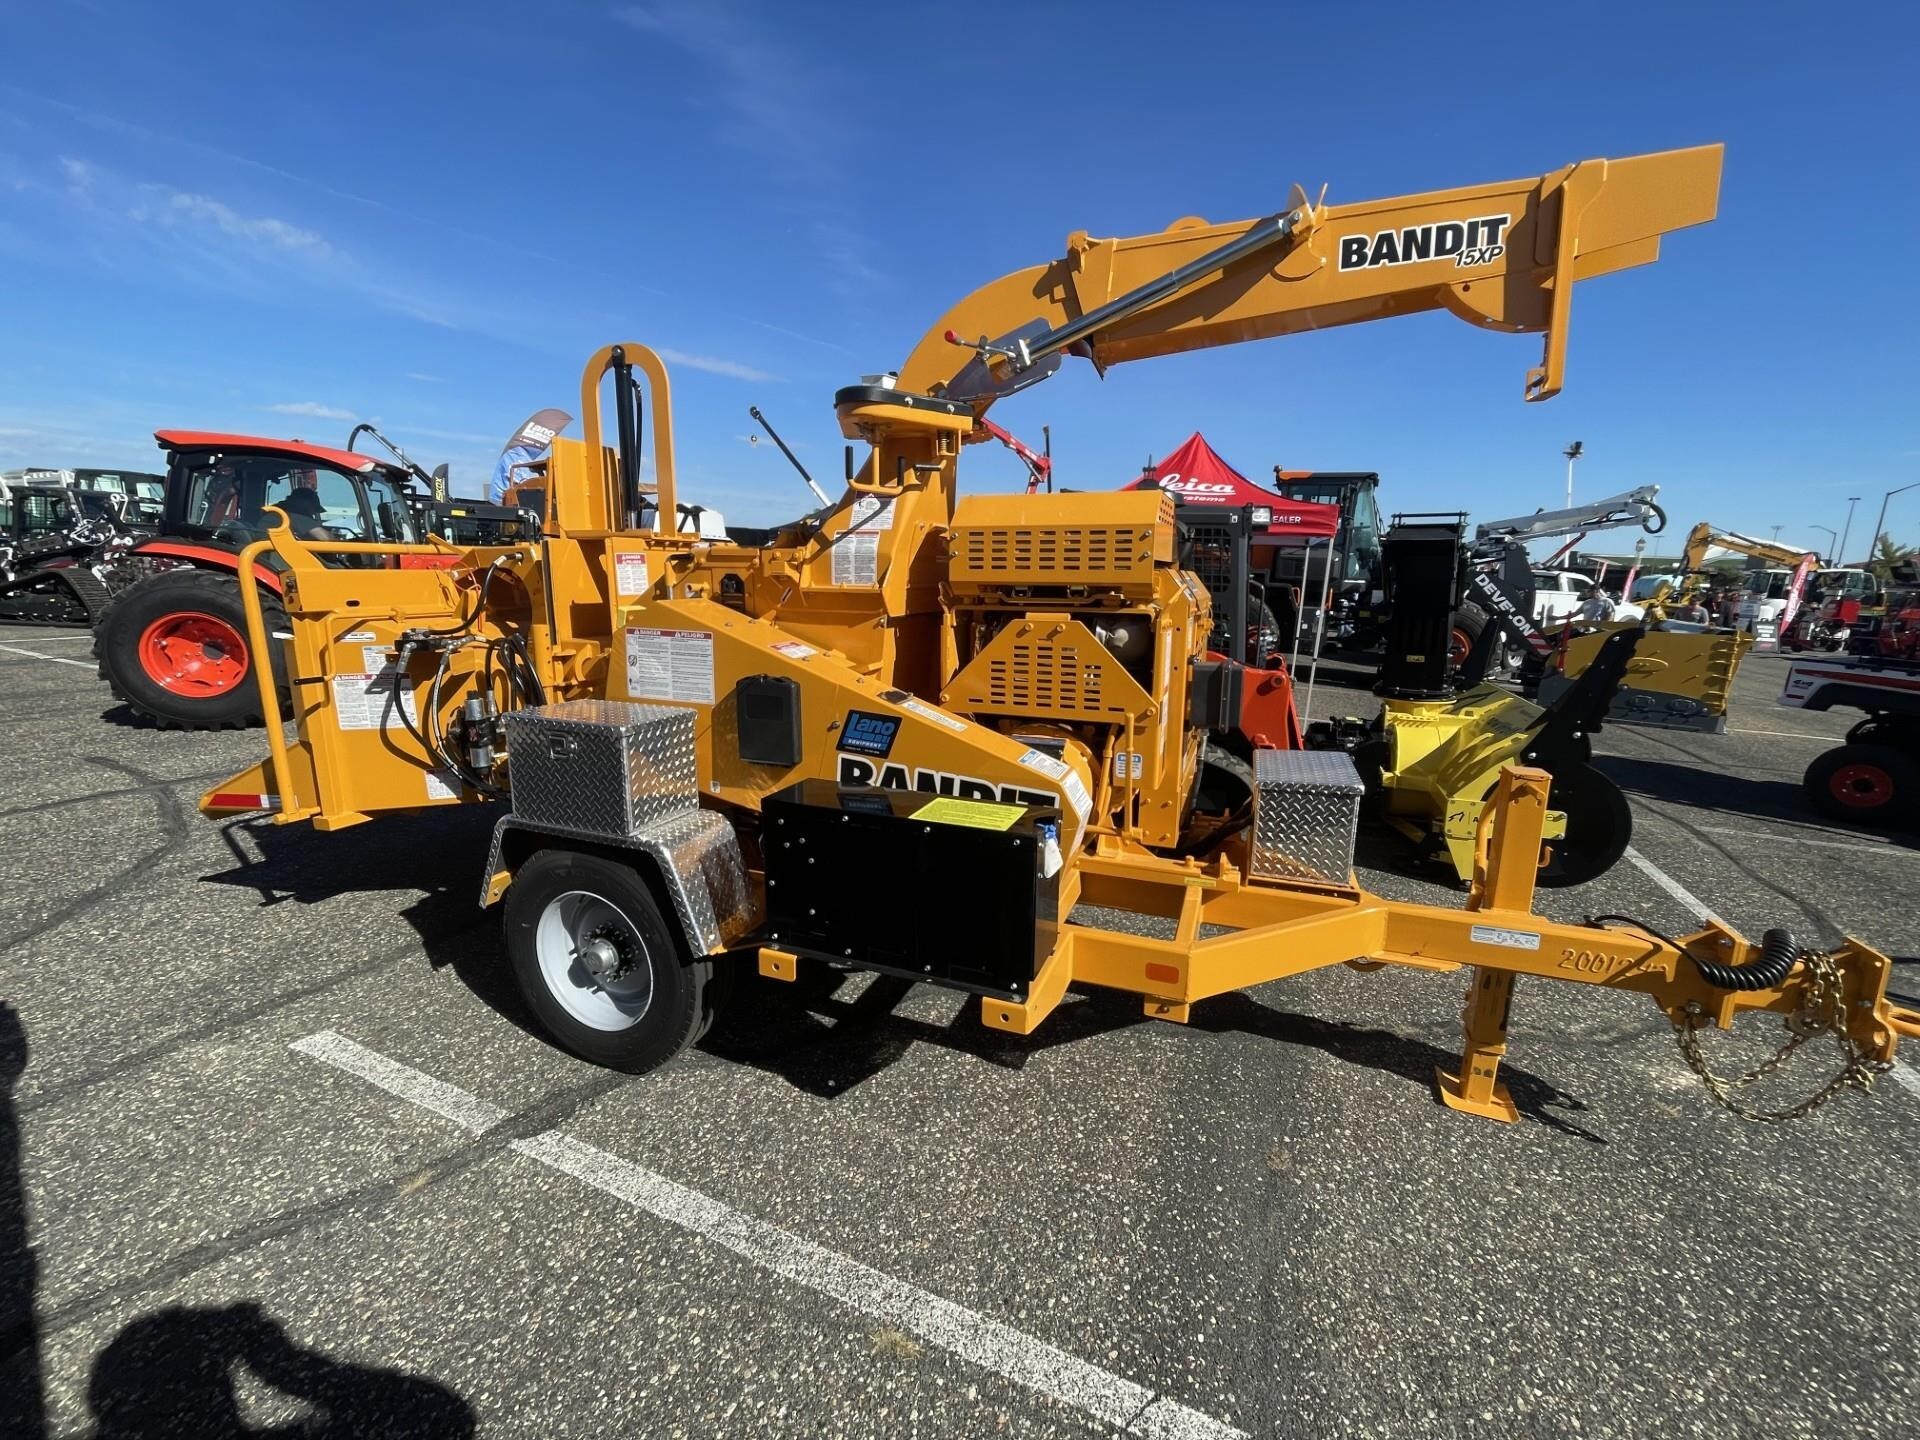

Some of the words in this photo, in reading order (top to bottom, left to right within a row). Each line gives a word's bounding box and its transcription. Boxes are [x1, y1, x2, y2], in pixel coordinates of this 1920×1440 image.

[1339, 216, 1509, 270] BANDIT
[1455, 246, 1504, 267] 15XP
[1159, 473, 1235, 495] Leica
[1272, 515, 1302, 524] EALER
[1474, 573, 1535, 637] DEVELON
[845, 712, 896, 738] Lano
[848, 738, 882, 748] EQUIPMENT
